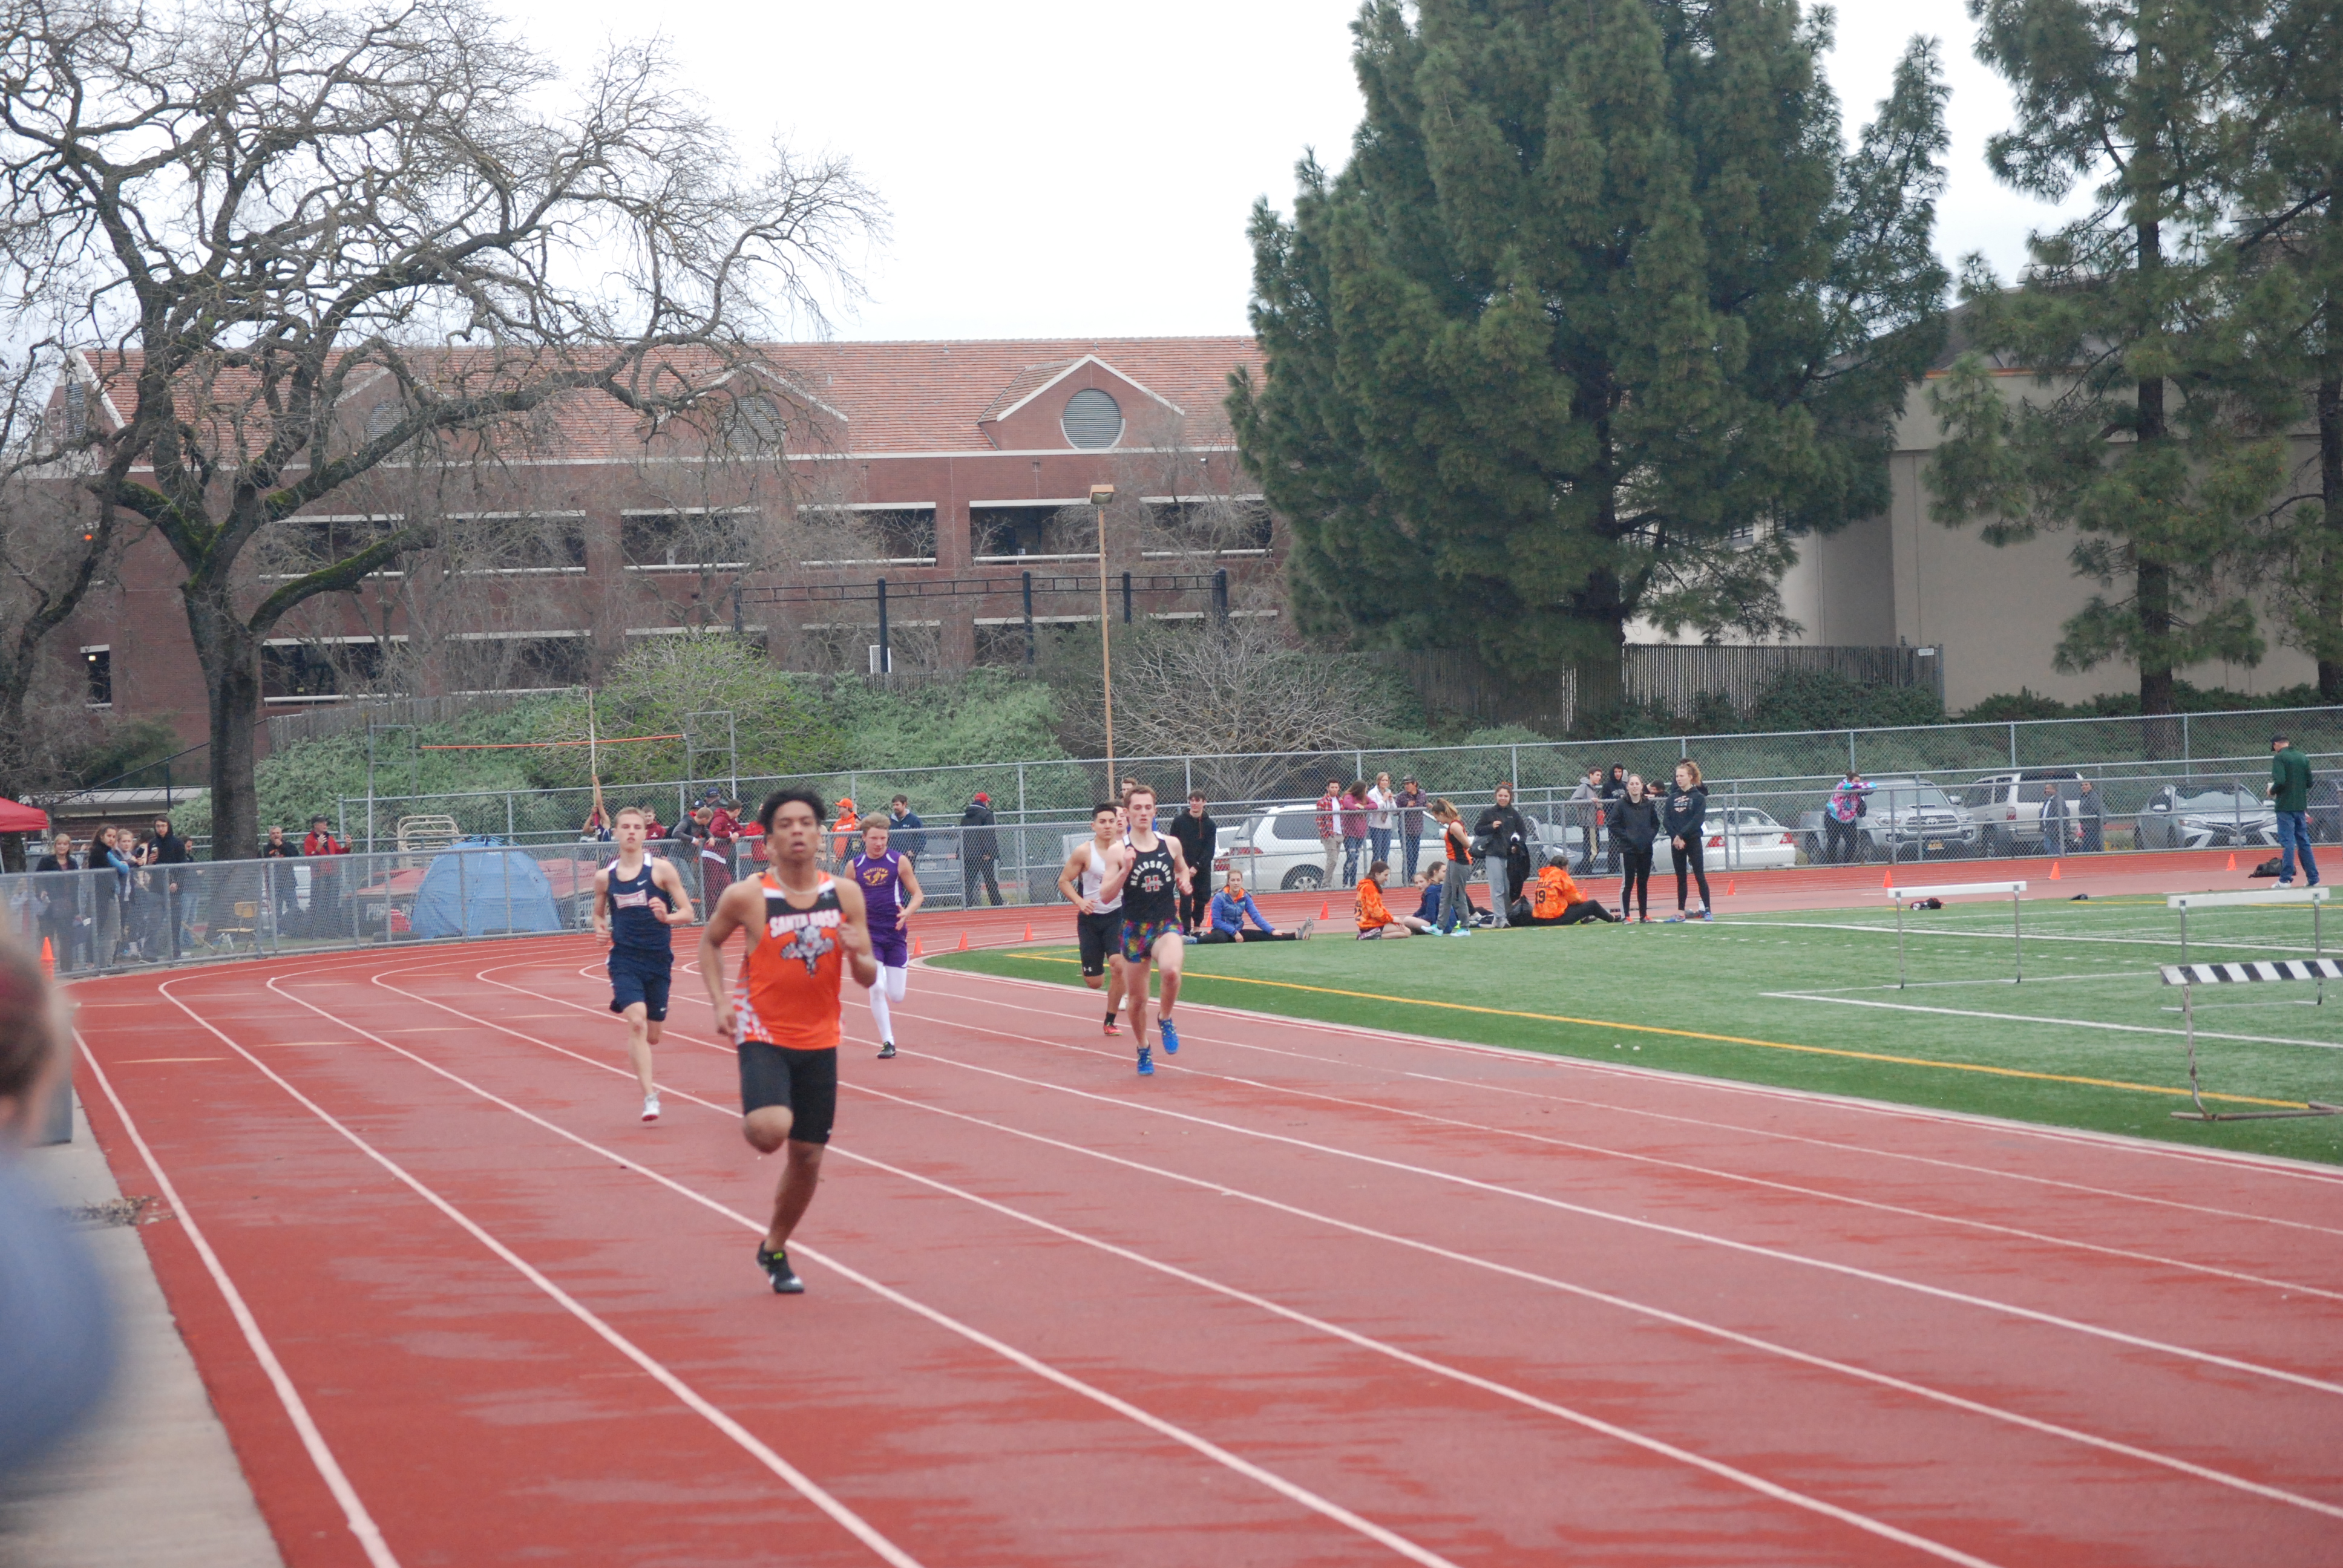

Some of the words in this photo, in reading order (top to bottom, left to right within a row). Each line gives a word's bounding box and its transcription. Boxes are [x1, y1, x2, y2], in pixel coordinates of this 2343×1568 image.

[1130, 860, 1171, 886] HEALDSBURG
[1535, 890, 1545, 904] 19
[769, 913, 808, 938] SANTA
[808, 909, 841, 929] ROSA
